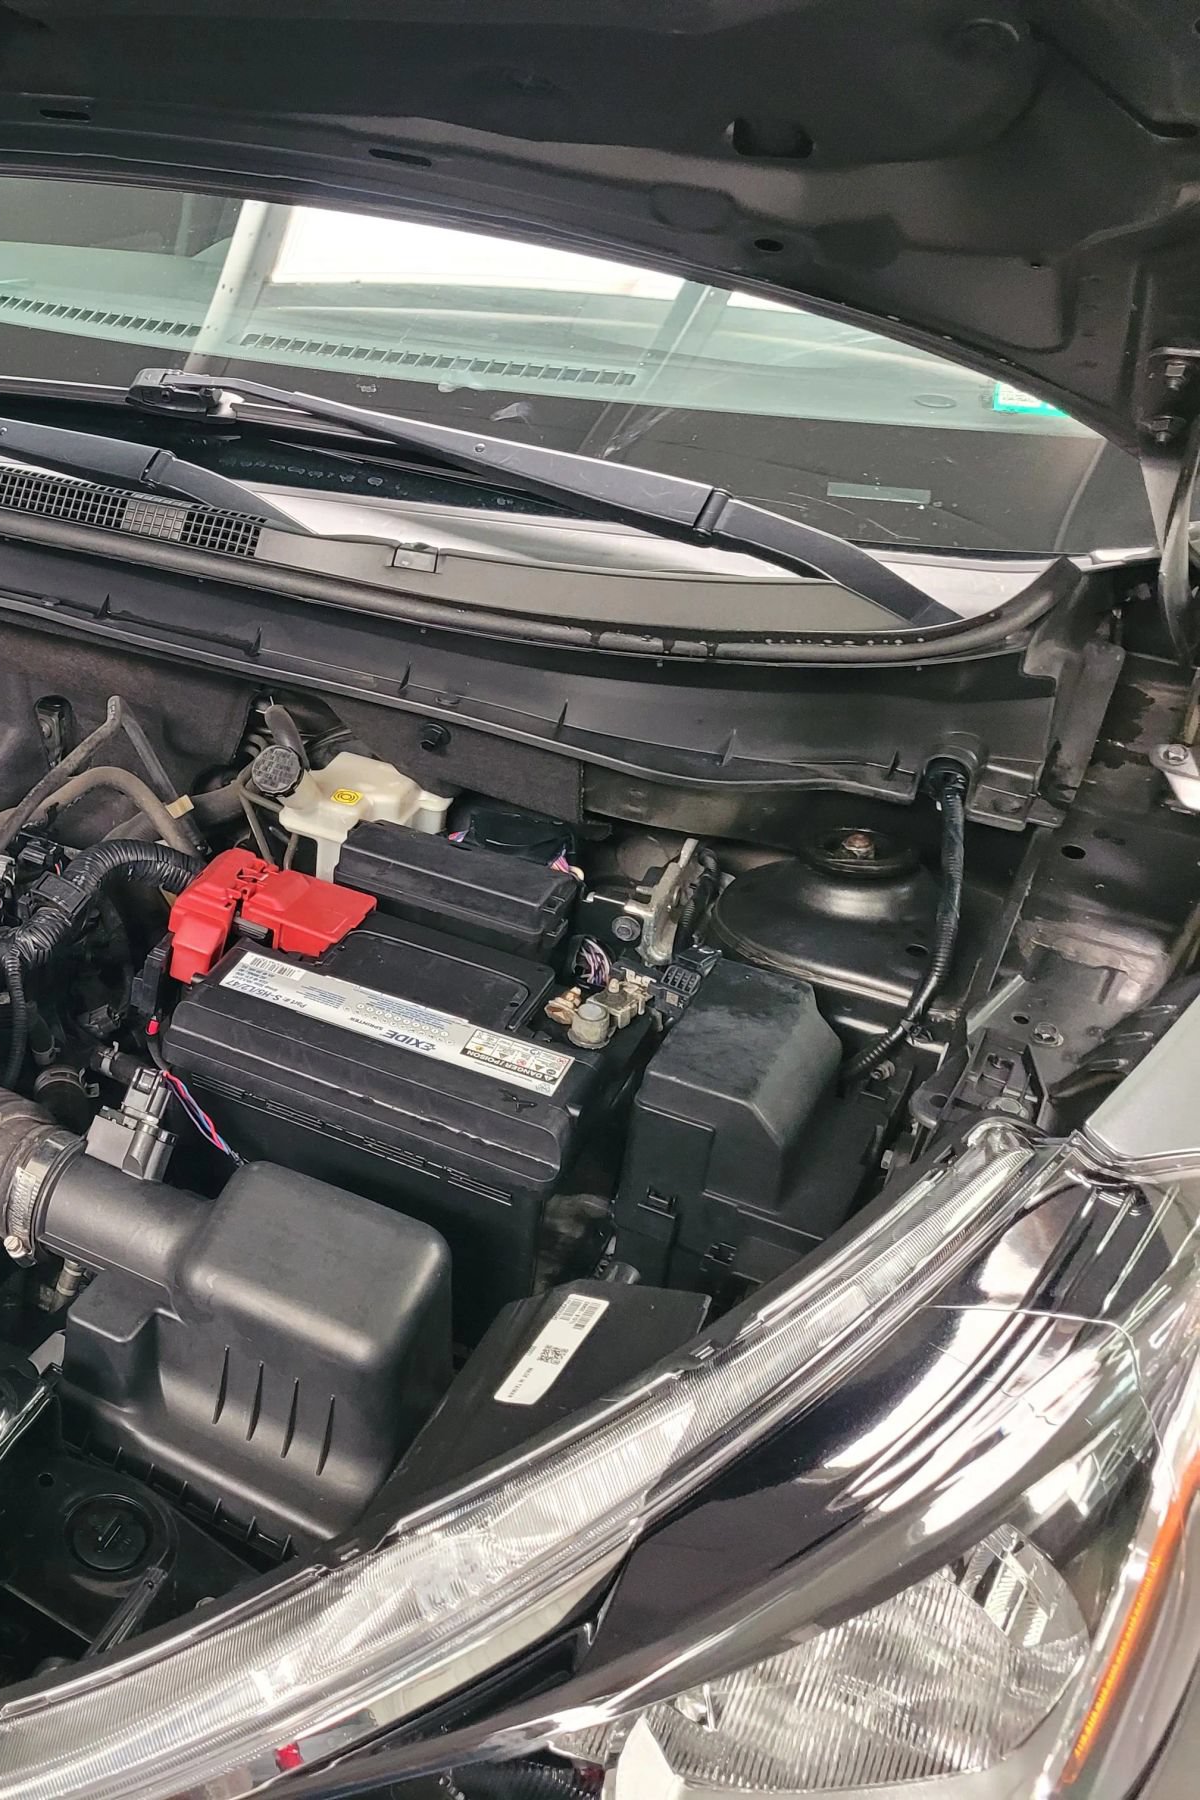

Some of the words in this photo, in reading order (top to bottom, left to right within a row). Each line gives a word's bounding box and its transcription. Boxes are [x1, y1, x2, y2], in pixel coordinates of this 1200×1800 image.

[291, 998, 307, 1009] Part
[350, 1017, 383, 1031] SPRINTER
[385, 1029, 432, 1051] EXIDE
[465, 1049, 500, 1065] POISON
[504, 1061, 543, 1079] DANGER
